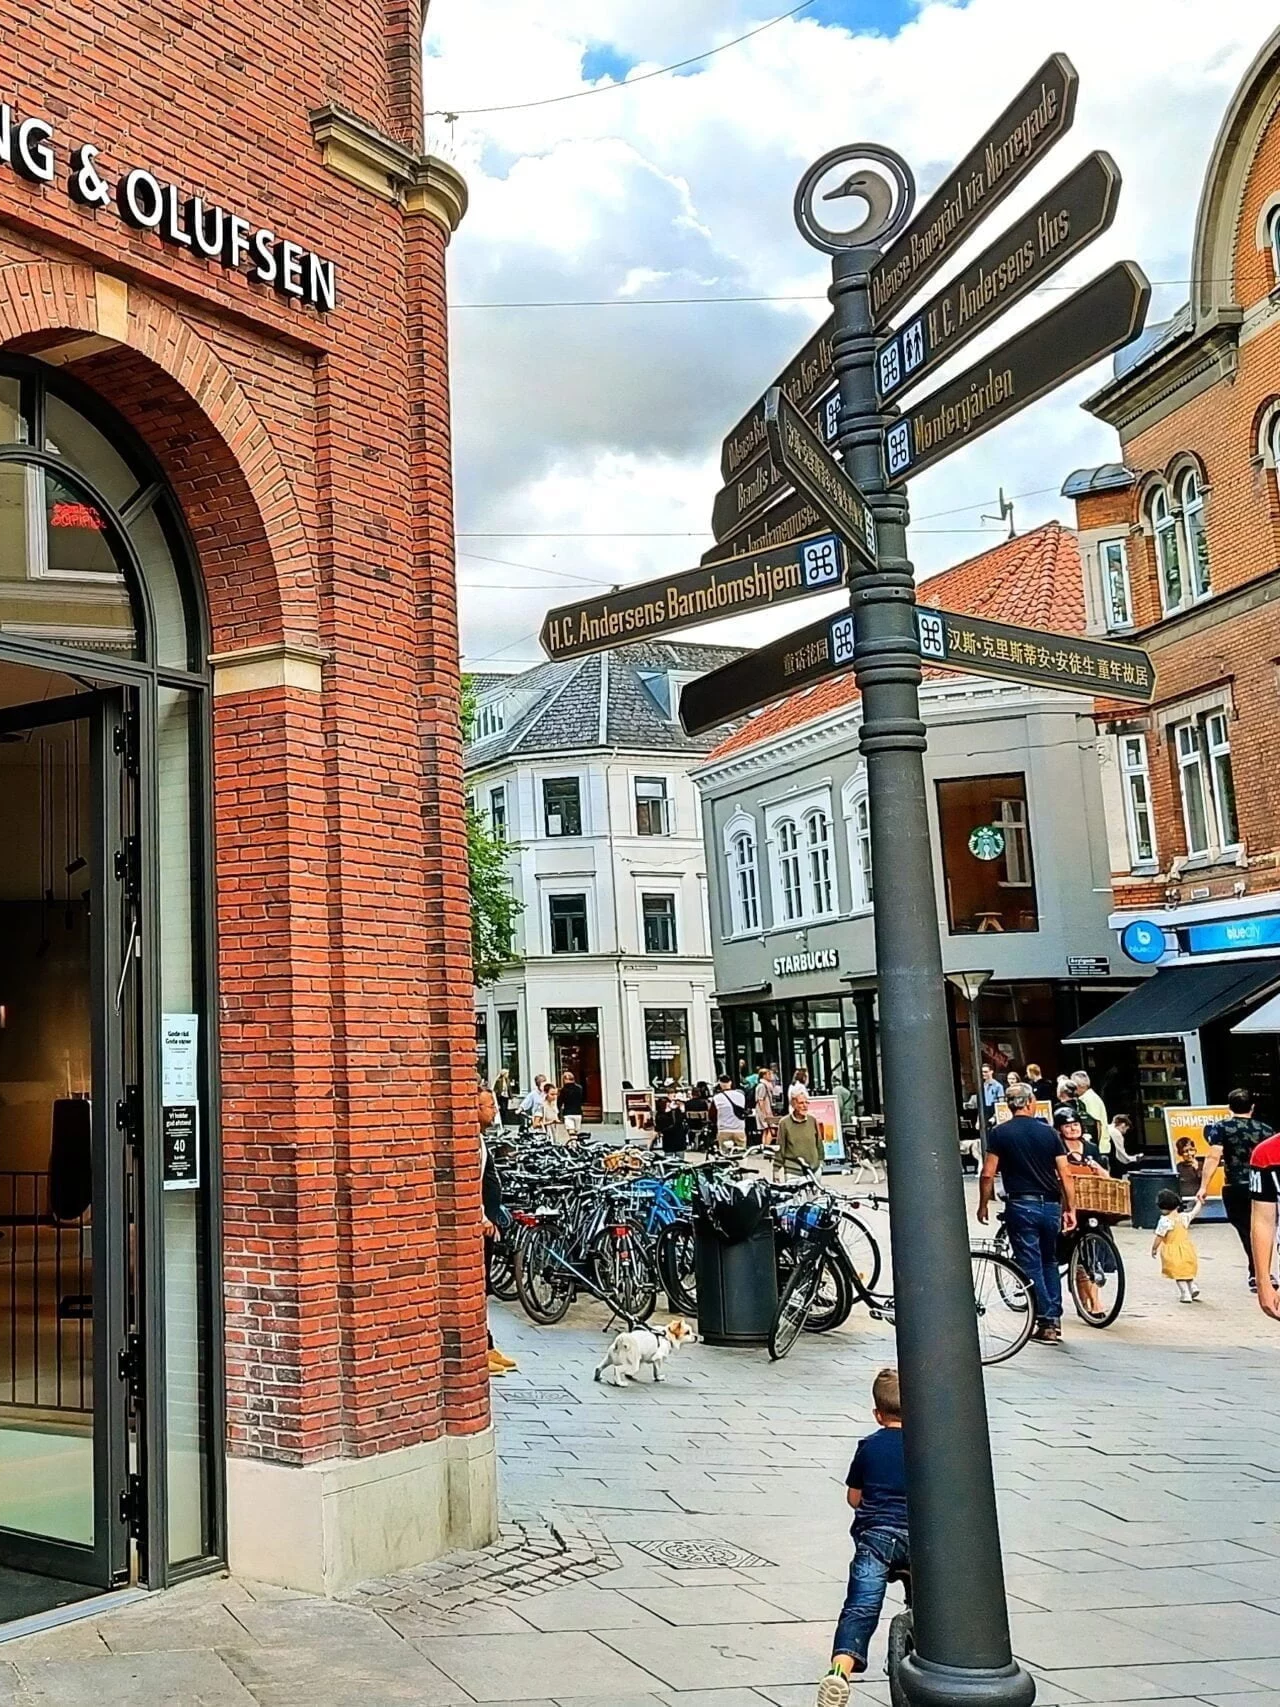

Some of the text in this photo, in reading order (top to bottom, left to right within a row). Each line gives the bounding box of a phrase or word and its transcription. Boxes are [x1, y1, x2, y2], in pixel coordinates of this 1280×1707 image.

[69, 143, 112, 208] &
[122, 168, 336, 312] OLUFSEN
[872, 254, 911, 313] Odense
[910, 181, 964, 272] Banegård
[965, 171, 986, 210] via
[958, 239, 1034, 327] Andersens
[1037, 208, 1070, 259] Hus
[913, 368, 1015, 456] Møntergården
[748, 503, 820, 553] Jernbanemuseu
[579, 600, 666, 643] Andersens
[667, 562, 803, 620] Barndomshjem
[773, 948, 838, 975] STARBUCKS
[173, 1139, 186, 1152] 40
